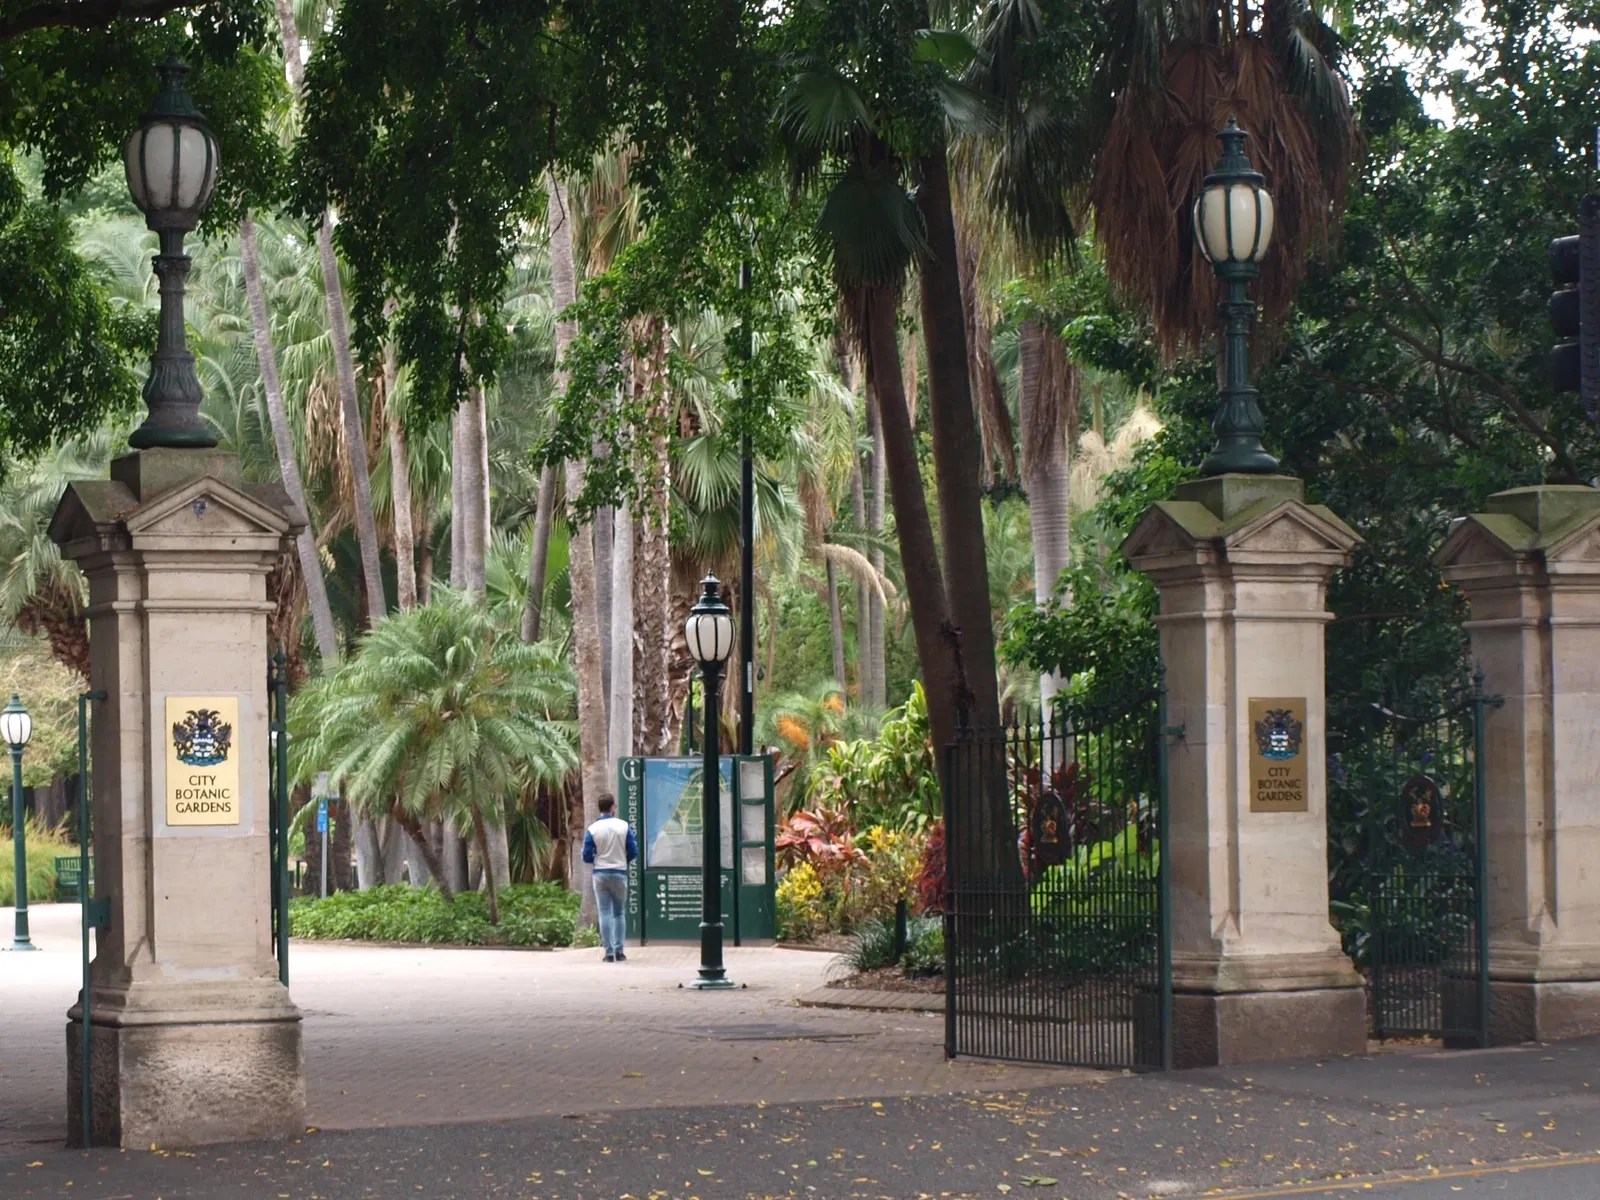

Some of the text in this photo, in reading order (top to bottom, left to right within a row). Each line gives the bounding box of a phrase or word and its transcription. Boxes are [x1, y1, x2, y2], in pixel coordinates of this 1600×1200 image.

[1268, 767, 1291, 777] CITY
[188, 775, 216, 786] CITY
[1257, 779, 1301, 789] BOTANIC
[175, 788, 231, 800] BOTANIC
[1257, 791, 1303, 801] GARDENS
[175, 802, 232, 813] GARDENS
[629, 858, 638, 886] BOTA
[629, 889, 638, 914] CITY
